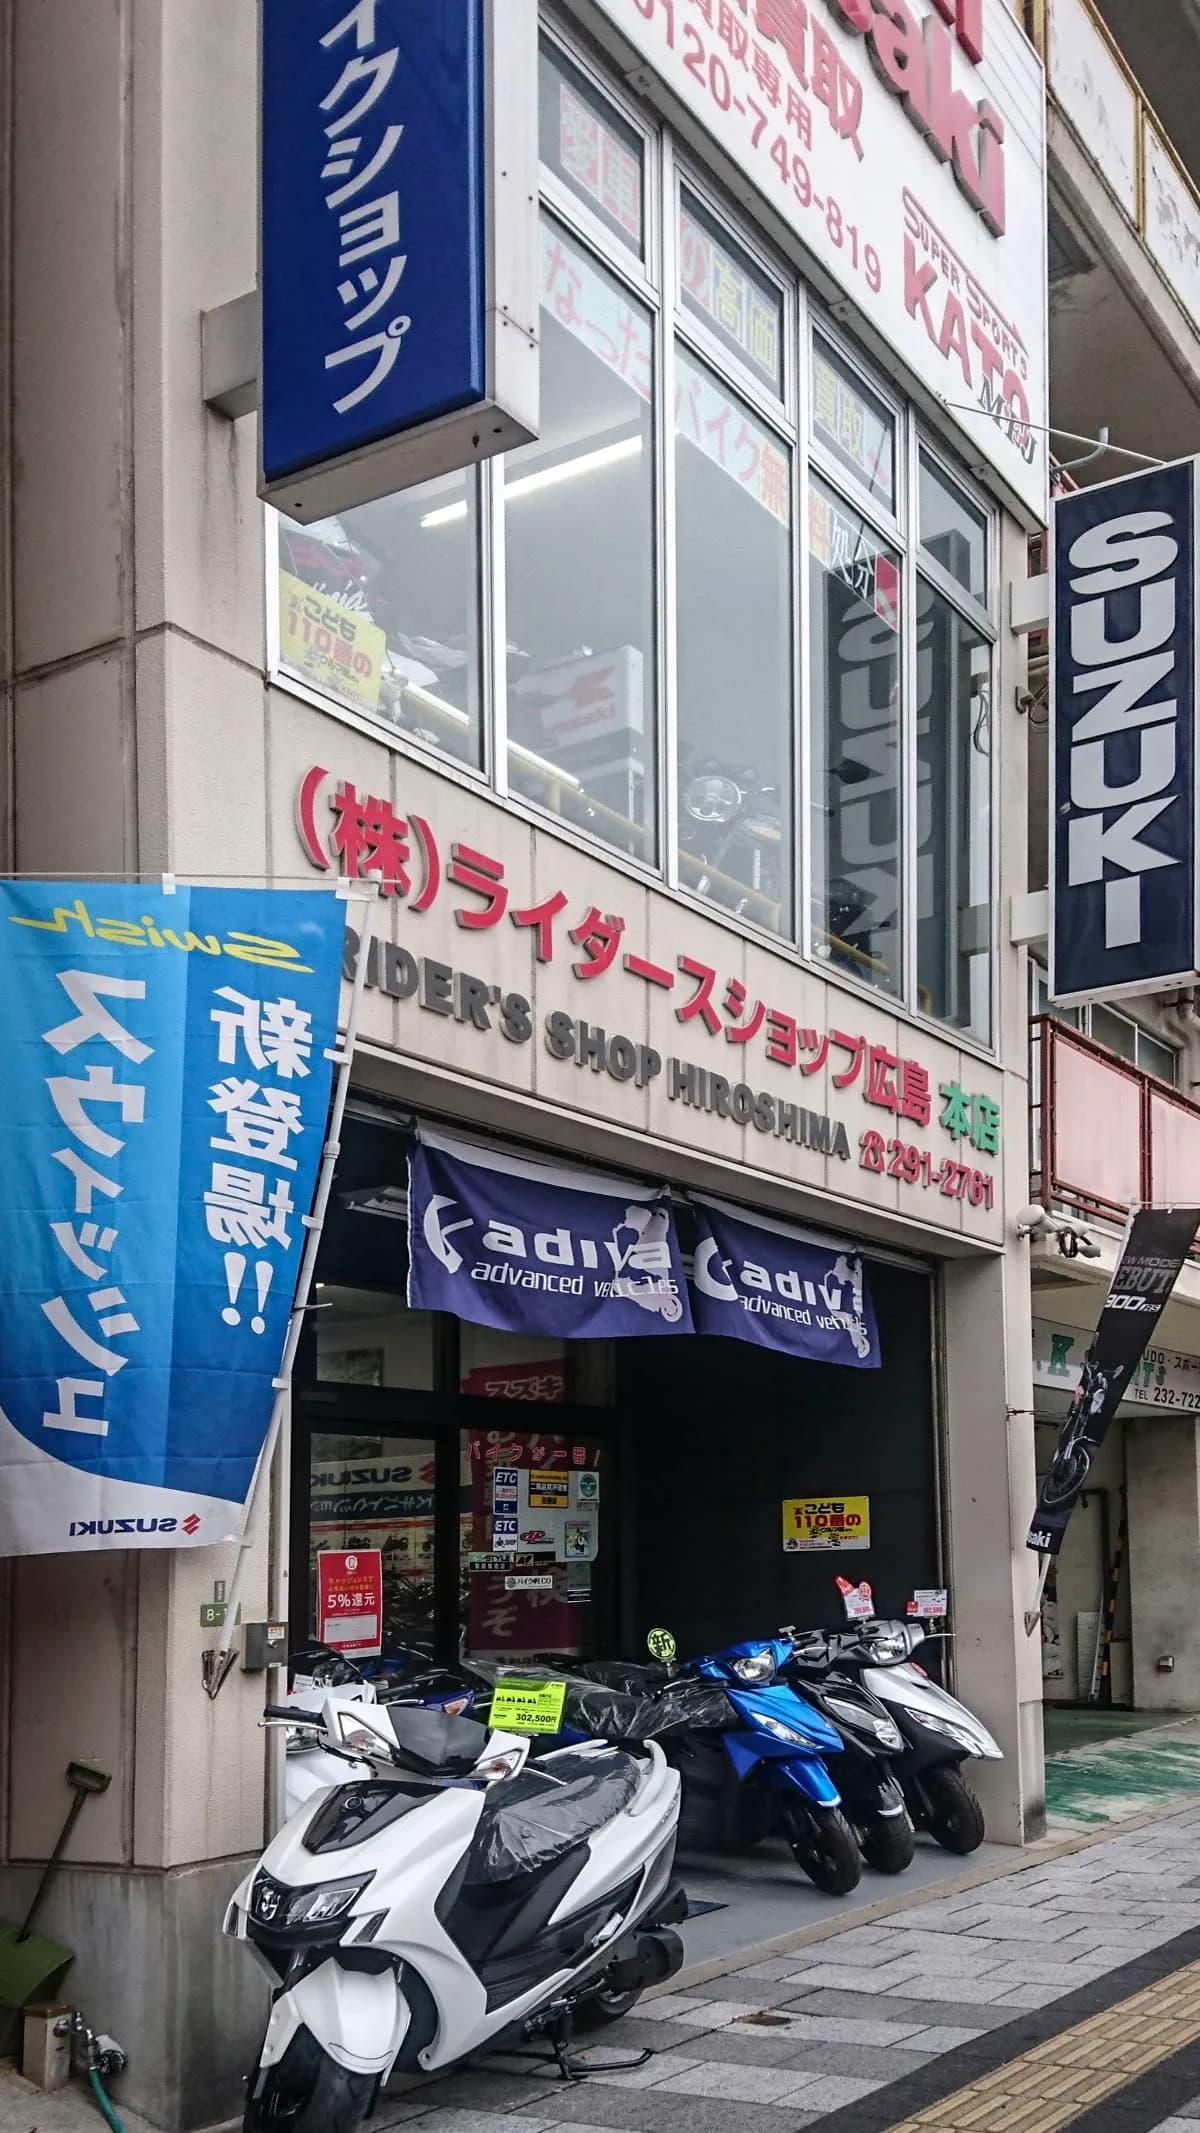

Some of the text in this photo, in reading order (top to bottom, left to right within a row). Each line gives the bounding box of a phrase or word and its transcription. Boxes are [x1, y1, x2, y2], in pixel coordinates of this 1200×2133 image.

[902, 186, 1028, 380] SUPER SPORTS
[1068, 511, 1182, 950] SUZUKI
[545, 1011, 662, 1088] SHOP
[667, 1057, 852, 1160] HIROSHIMA
[938, 1081, 1000, 1155] 本店
[470, 1262, 583, 1296] advanced
[1134, 1388, 1148, 1400] TEL
[496, 1472, 517, 1483] ETC
[805, 1503, 844, 1515] こども
[495, 1521, 516, 1531] ETC
[327, 1592, 376, 1609] 5%還元
[515, 1713, 558, 1724] 302,500円
